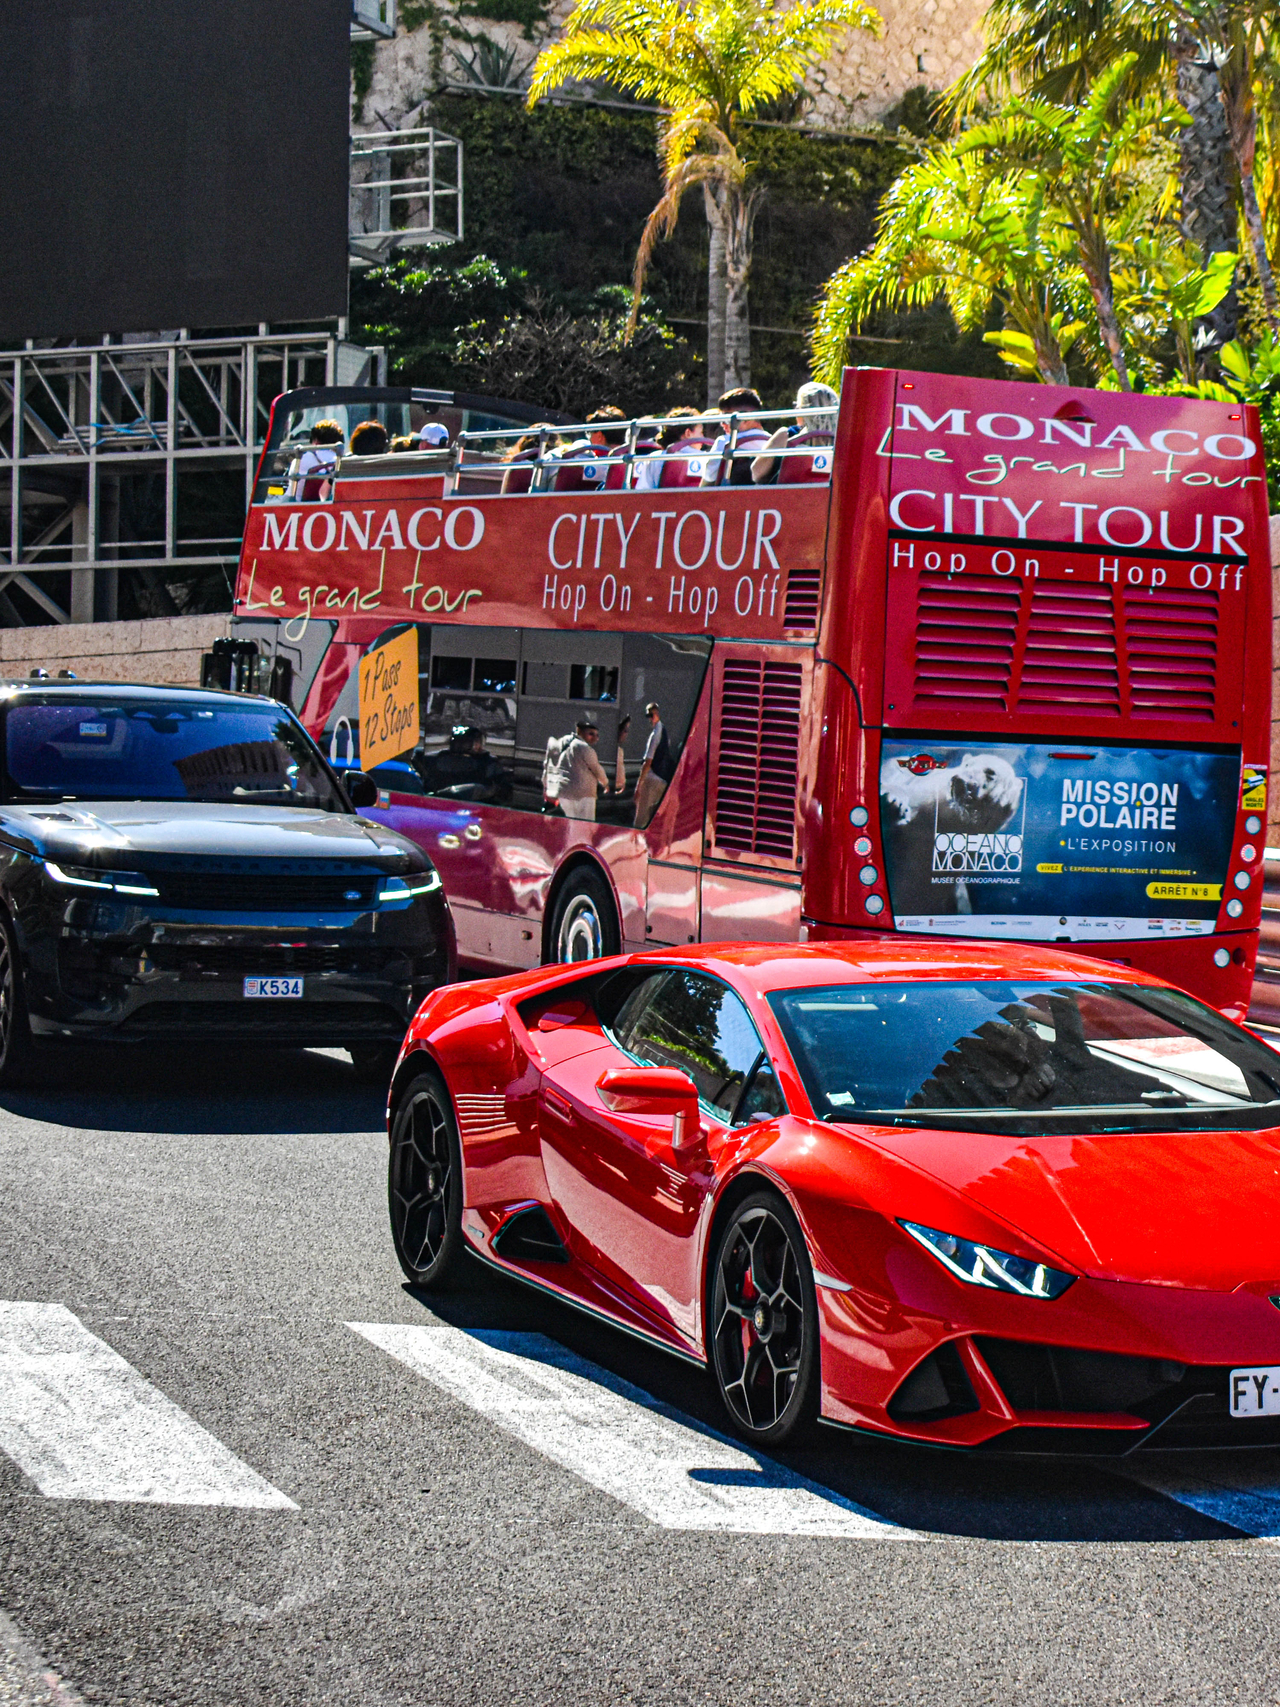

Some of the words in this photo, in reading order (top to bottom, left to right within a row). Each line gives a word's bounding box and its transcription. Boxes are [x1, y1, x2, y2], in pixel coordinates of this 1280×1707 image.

[876, 426, 954, 464] Le
[966, 447, 1125, 486] grand
[1152, 453, 1262, 489] tour
[896, 403, 1256, 461] MONACO
[259, 506, 485, 552] MONACO
[548, 513, 641, 570] CITY
[651, 508, 782, 571] TOUR
[889, 489, 1043, 540] CITY
[1059, 501, 1249, 557] TOUR
[892, 542, 967, 580] Hop
[991, 549, 1040, 578] On
[1099, 557, 1167, 594] Hop
[1189, 563, 1245, 591] Off
[245, 558, 286, 610] Le
[285, 547, 386, 642] grand
[402, 549, 483, 612] tour
[542, 574, 586, 622] Hop
[600, 573, 632, 612] On
[668, 575, 718, 627] Hop
[734, 573, 781, 617] Off
[364, 668, 371, 703] 1
[371, 651, 402, 700] Pass
[364, 712, 379, 750] 12
[380, 693, 415, 751] Stops
[1062, 778, 1179, 807] MISSION
[932, 851, 1022, 872] MONACO
[1067, 837, 1177, 853] L'EXPOSITION
[1152, 885, 1188, 896] ARRÊT
[259, 979, 300, 996] K534
